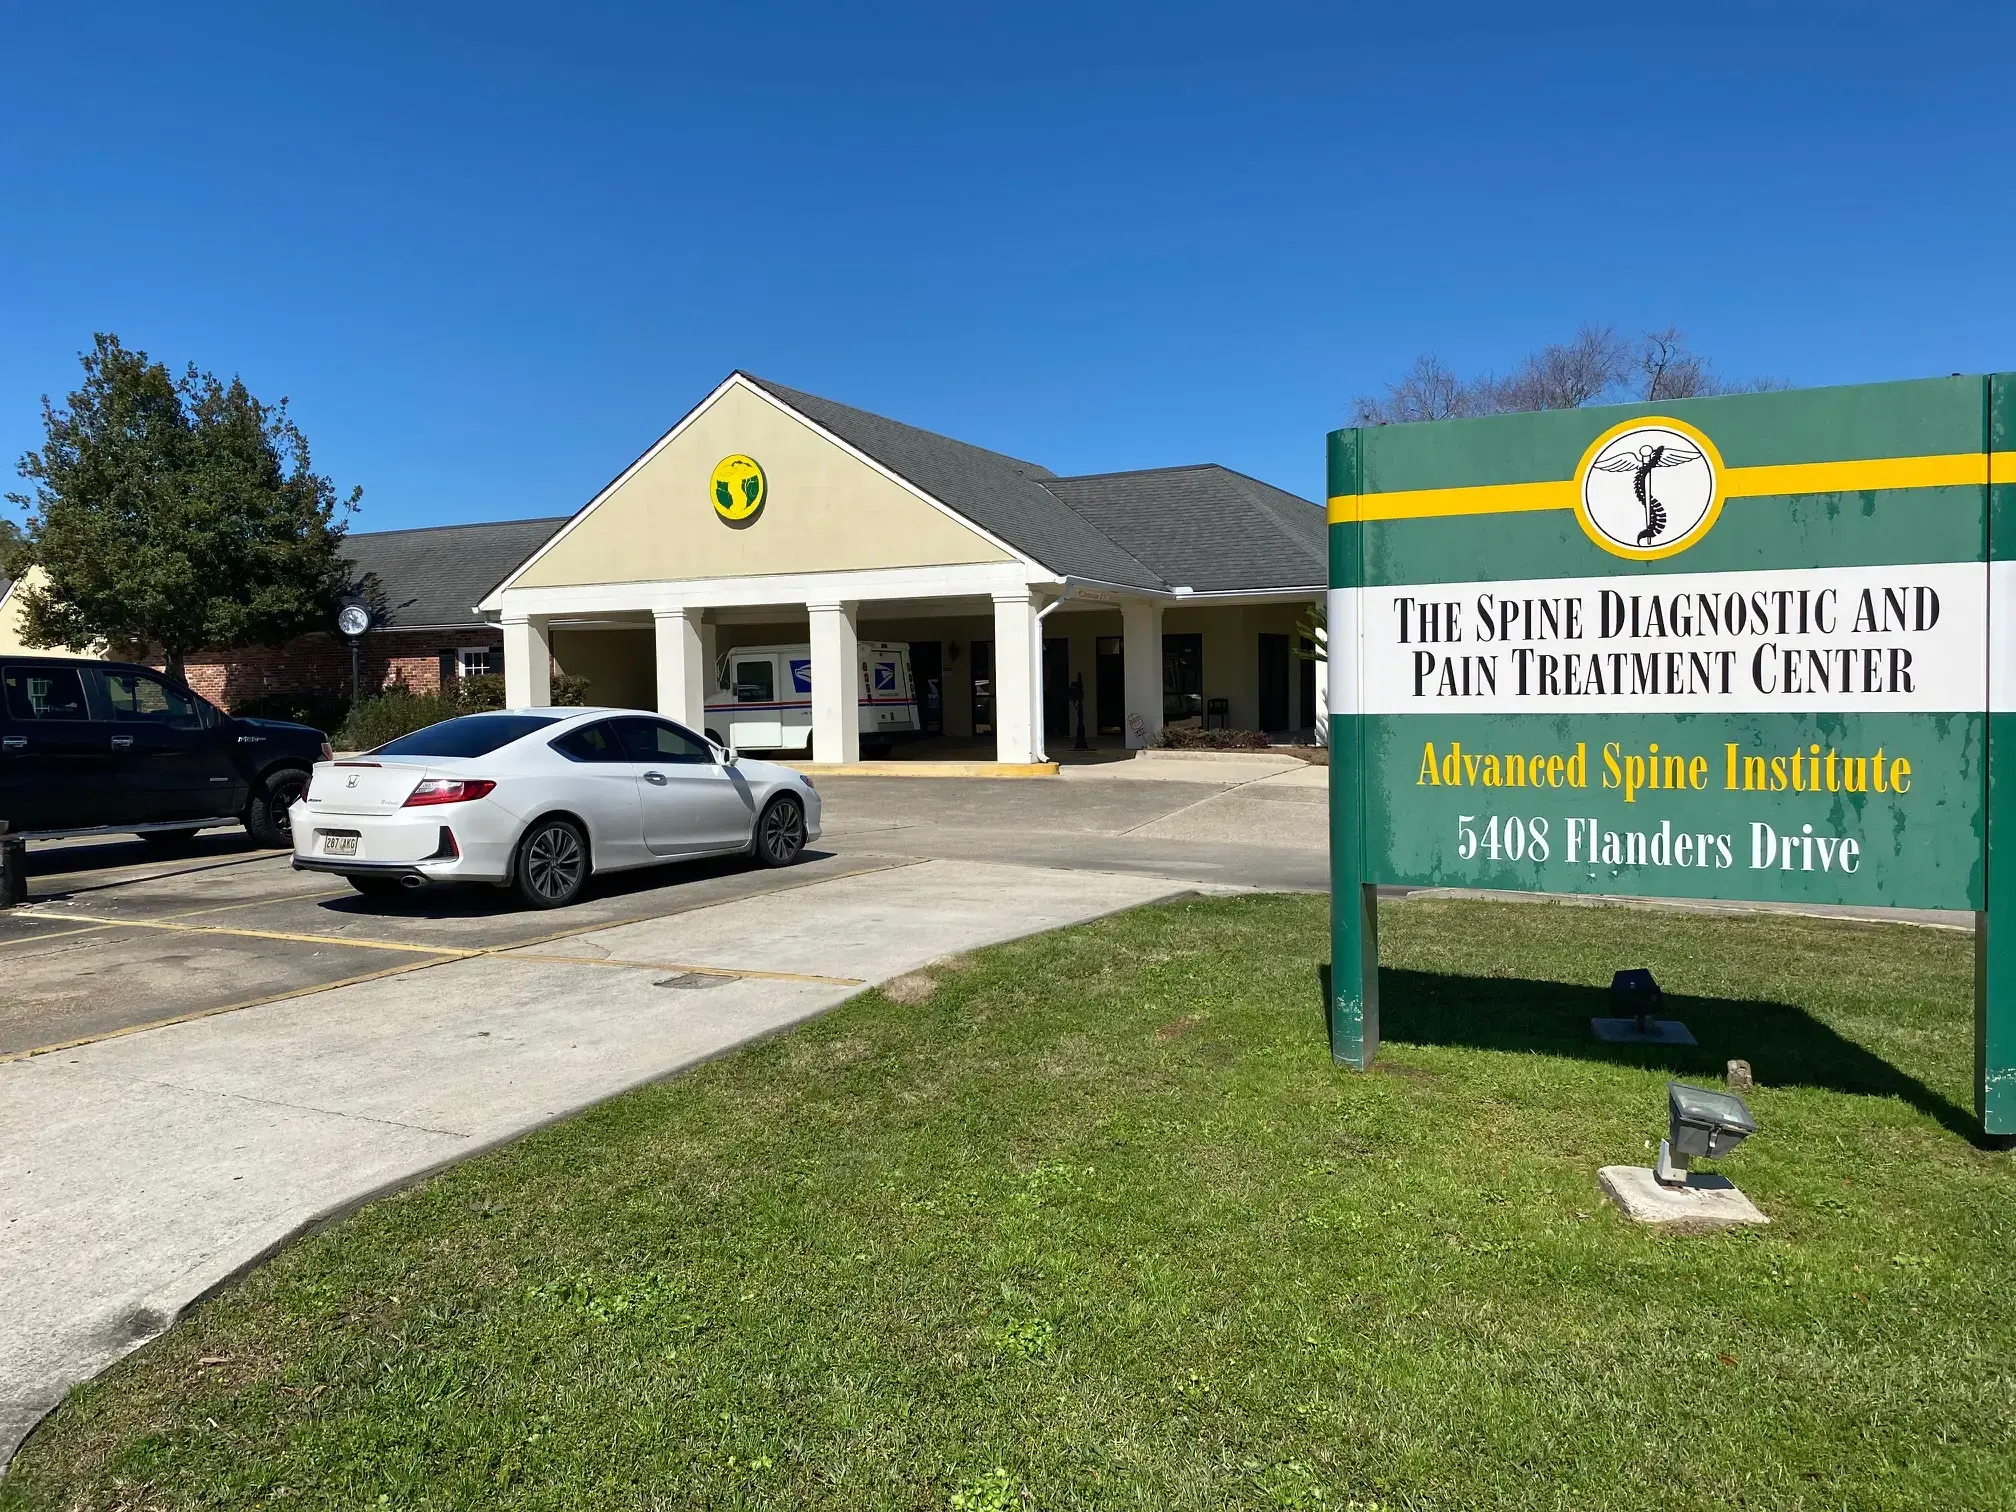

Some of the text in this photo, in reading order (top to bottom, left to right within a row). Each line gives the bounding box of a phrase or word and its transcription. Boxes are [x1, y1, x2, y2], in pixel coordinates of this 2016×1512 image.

[1393, 585, 1940, 643] THE SPINE DIAGNOSTIC AND
[1412, 642, 1916, 697] PAIN TREATMENT CENTER
[1416, 742, 1912, 803] Advanced Spine Institute
[1458, 814, 1860, 874] 5408 Flanders Drive
